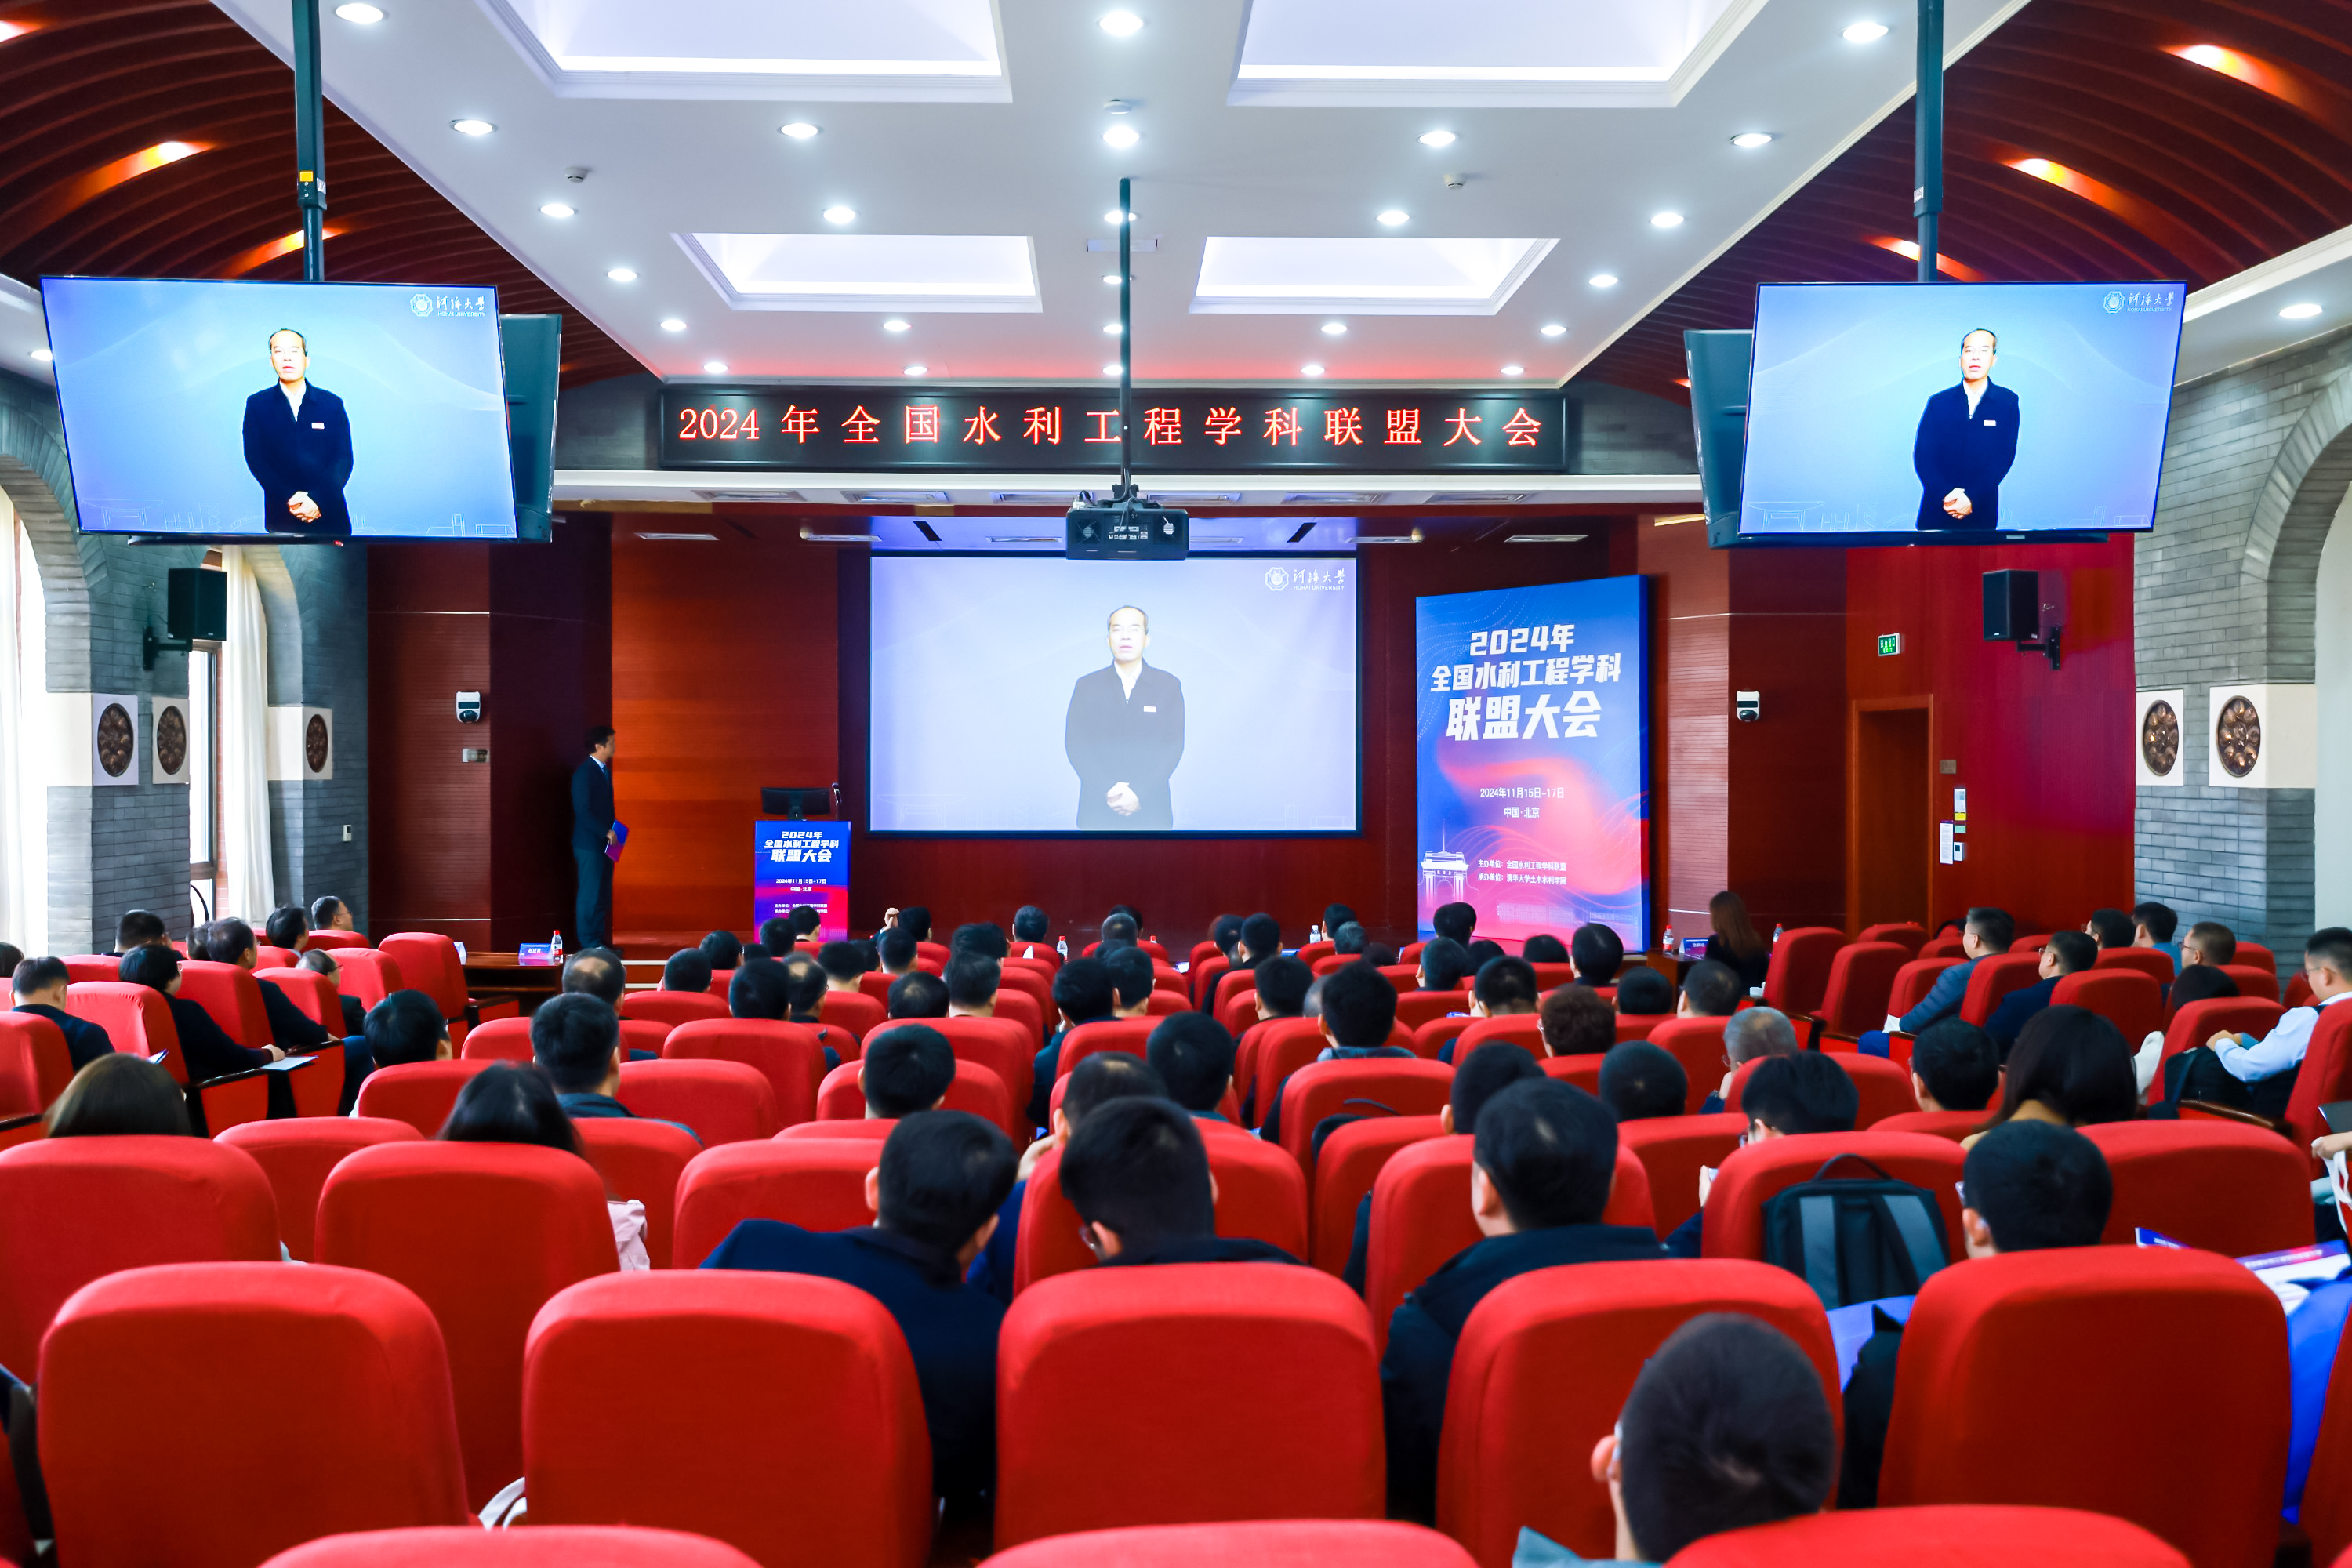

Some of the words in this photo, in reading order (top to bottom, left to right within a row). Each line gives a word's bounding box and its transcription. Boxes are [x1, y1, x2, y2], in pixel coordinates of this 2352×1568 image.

[1470, 624, 1575, 656] 2024年
[1430, 653, 1621, 692] 全国水利工程学科
[1446, 690, 1602, 741] 联盟大会
[764, 840, 840, 848] 全国水利工程学科
[781, 831, 822, 840] 2024年
[771, 849, 833, 862] 联盟大会
